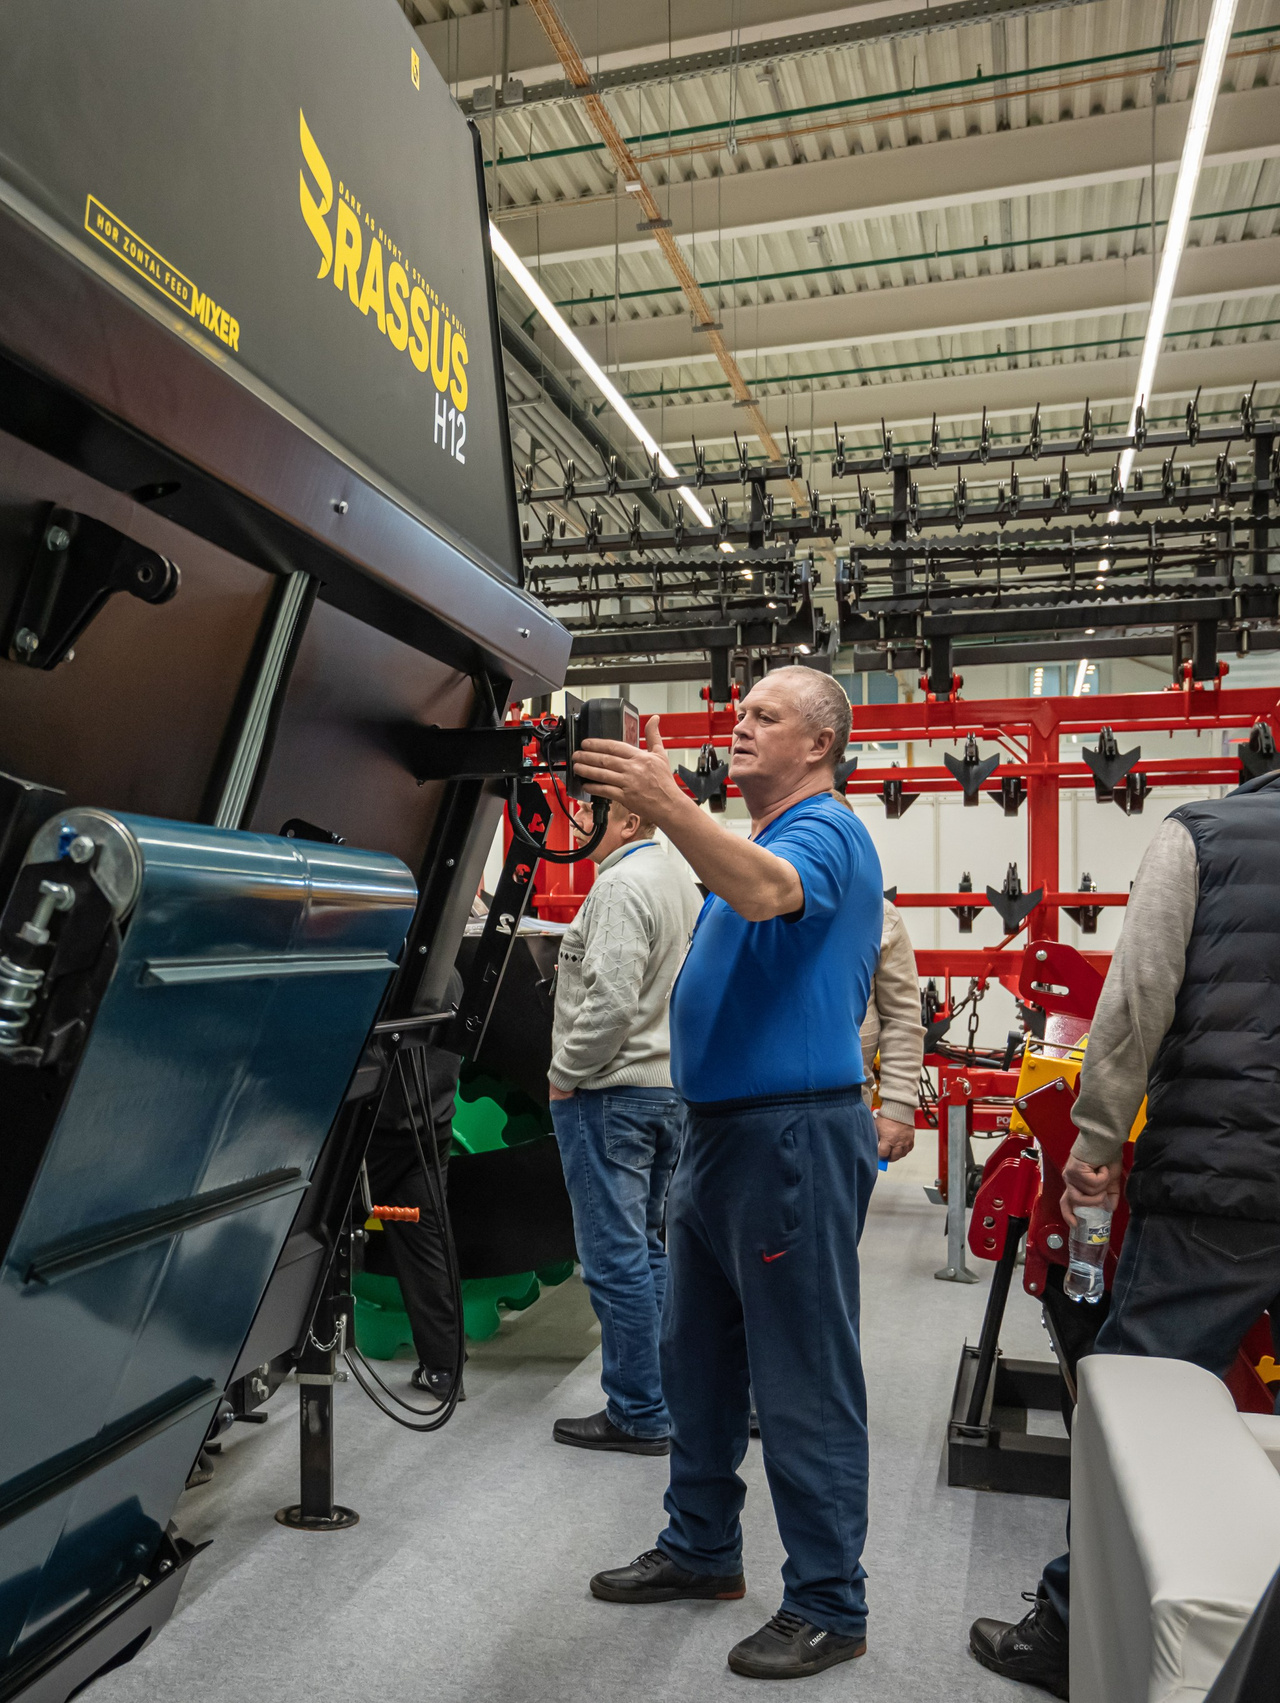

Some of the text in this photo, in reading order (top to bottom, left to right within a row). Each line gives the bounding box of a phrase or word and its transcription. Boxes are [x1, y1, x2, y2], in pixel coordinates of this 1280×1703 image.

[338, 180, 362, 216] DARK
[365, 212, 376, 232] AS
[378, 227, 402, 263] NIGHT
[412, 268, 439, 306] STRONG
[441, 302, 450, 319] AS
[452, 313, 467, 339] BULL
[164, 271, 189, 301] FEED
[194, 287, 240, 352] MIXER
[434, 392, 466, 465] H12
